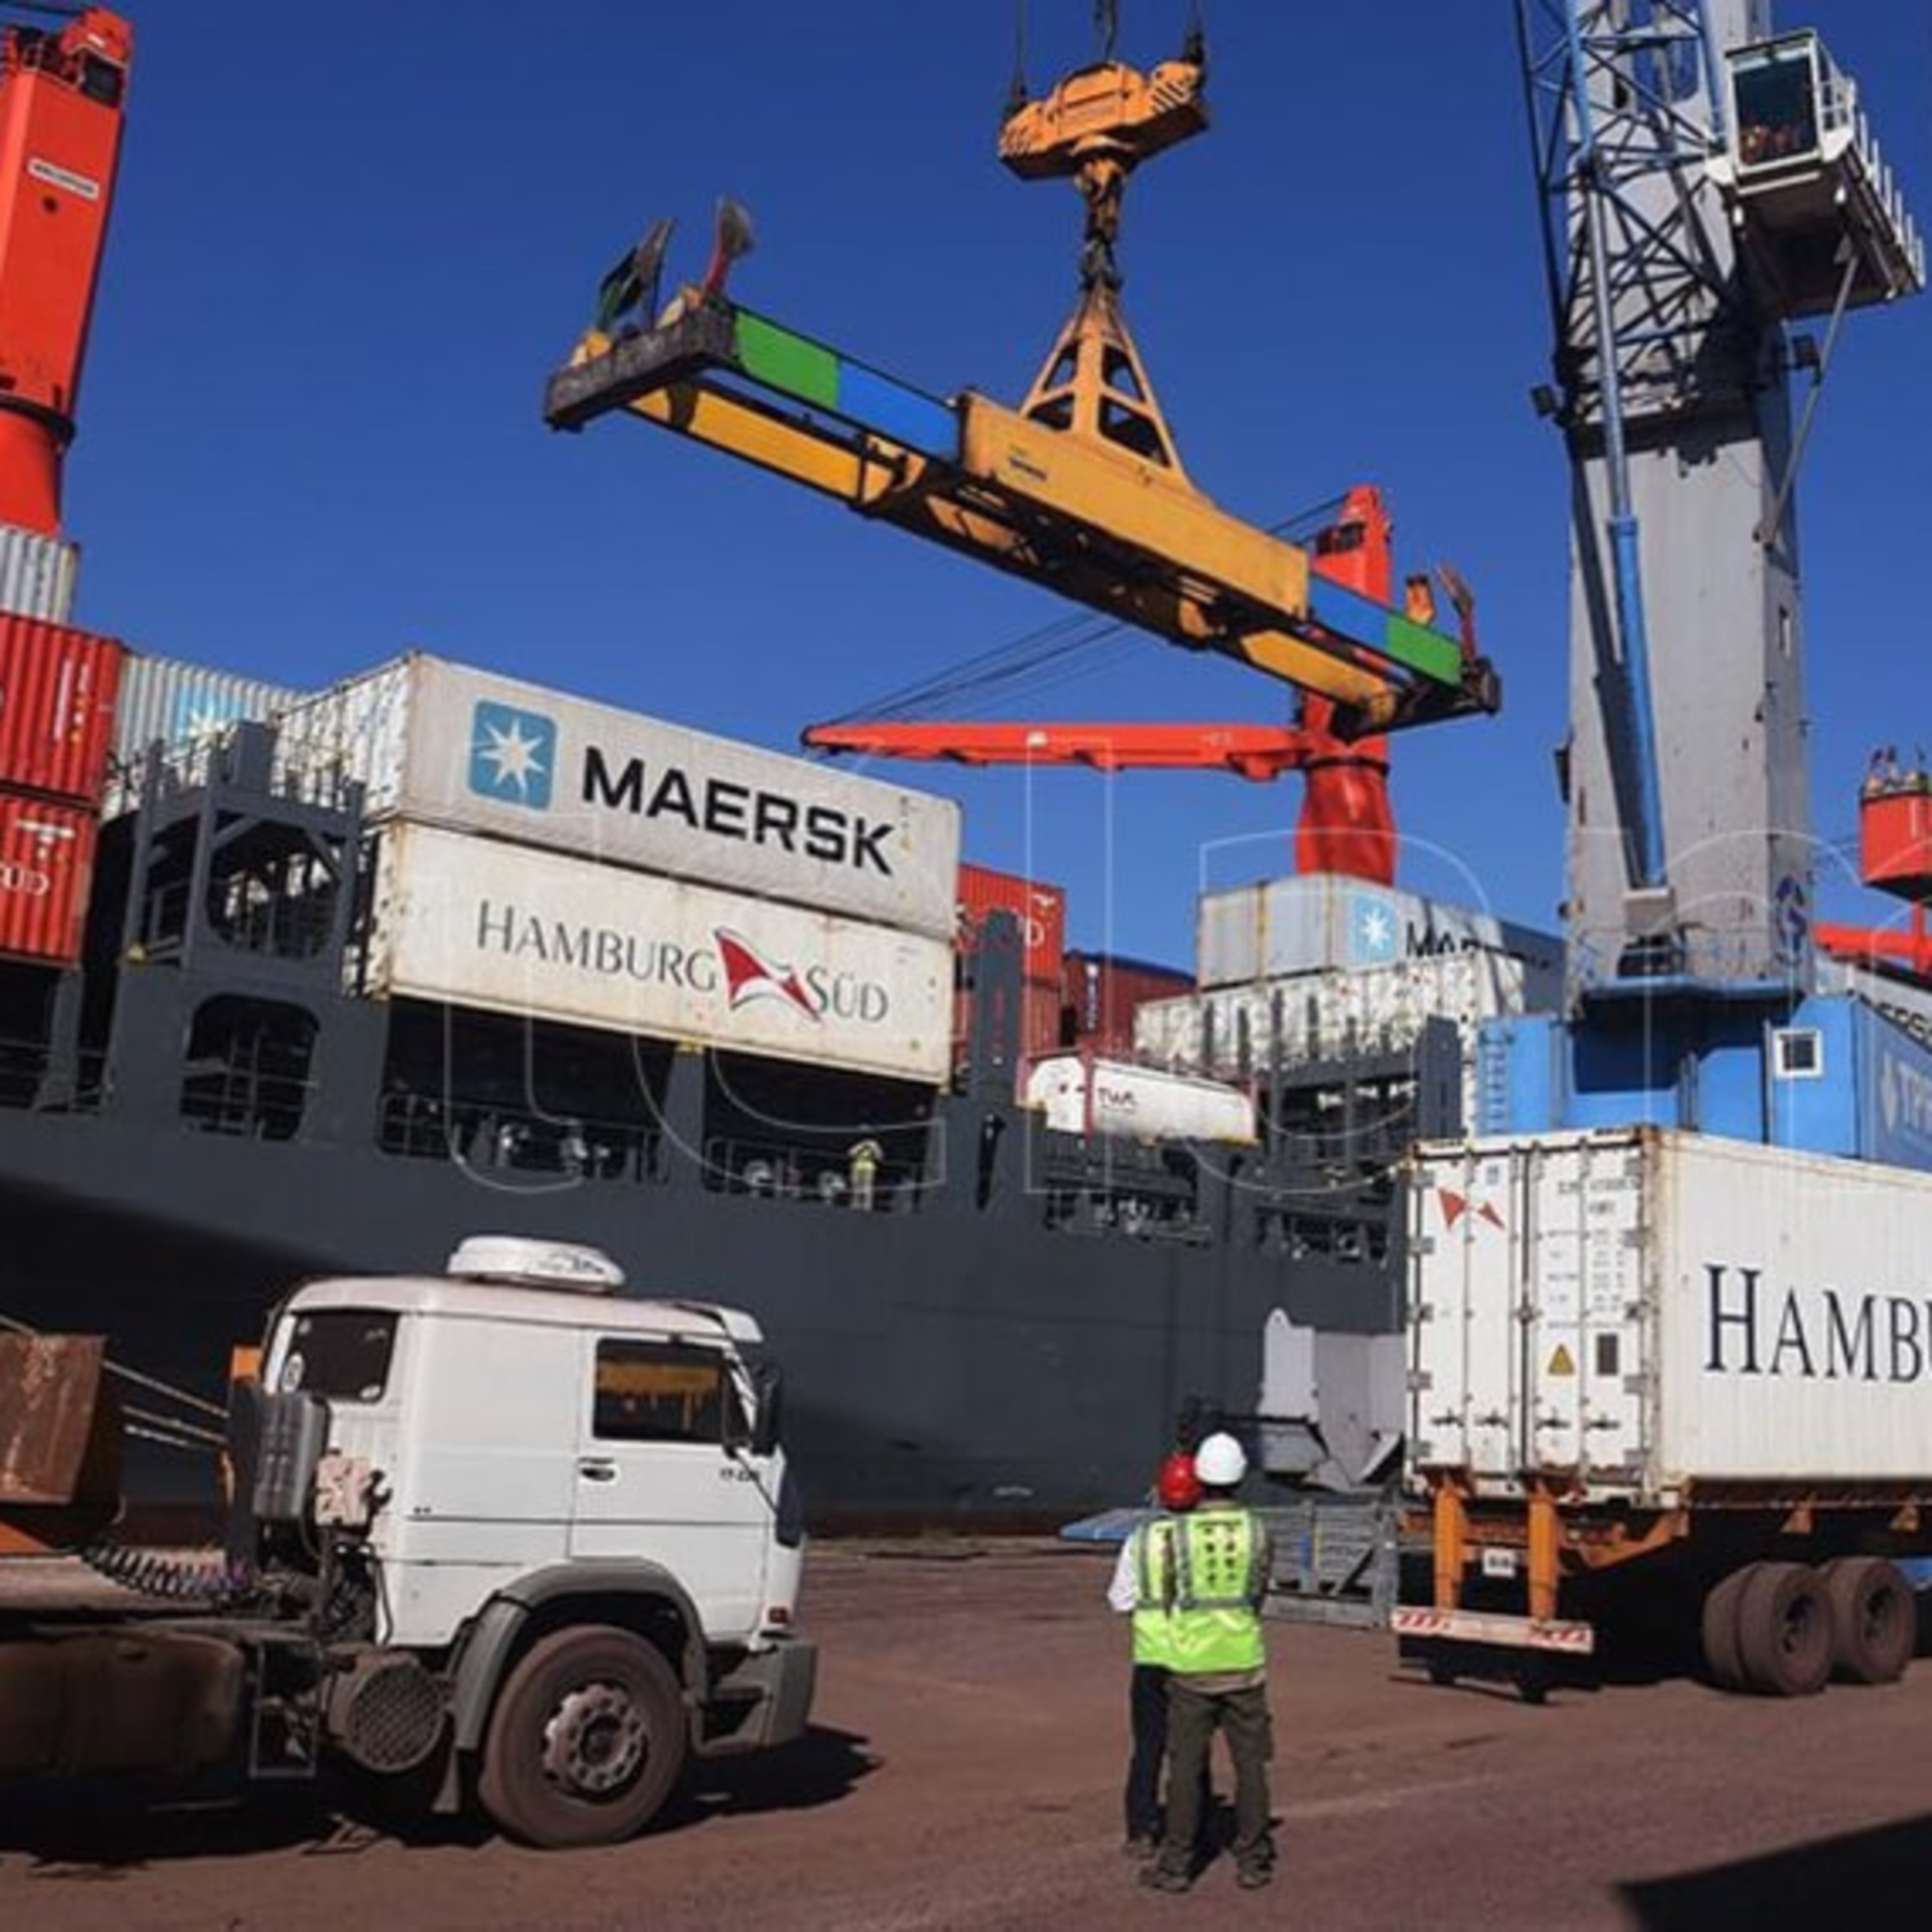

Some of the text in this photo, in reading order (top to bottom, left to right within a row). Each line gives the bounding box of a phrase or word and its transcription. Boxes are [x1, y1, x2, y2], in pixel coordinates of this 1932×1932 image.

[582, 746, 895, 876] MAERSK
[477, 900, 889, 1022] HAMBURG SÜD
[1702, 1264, 1932, 1383] HAMB
